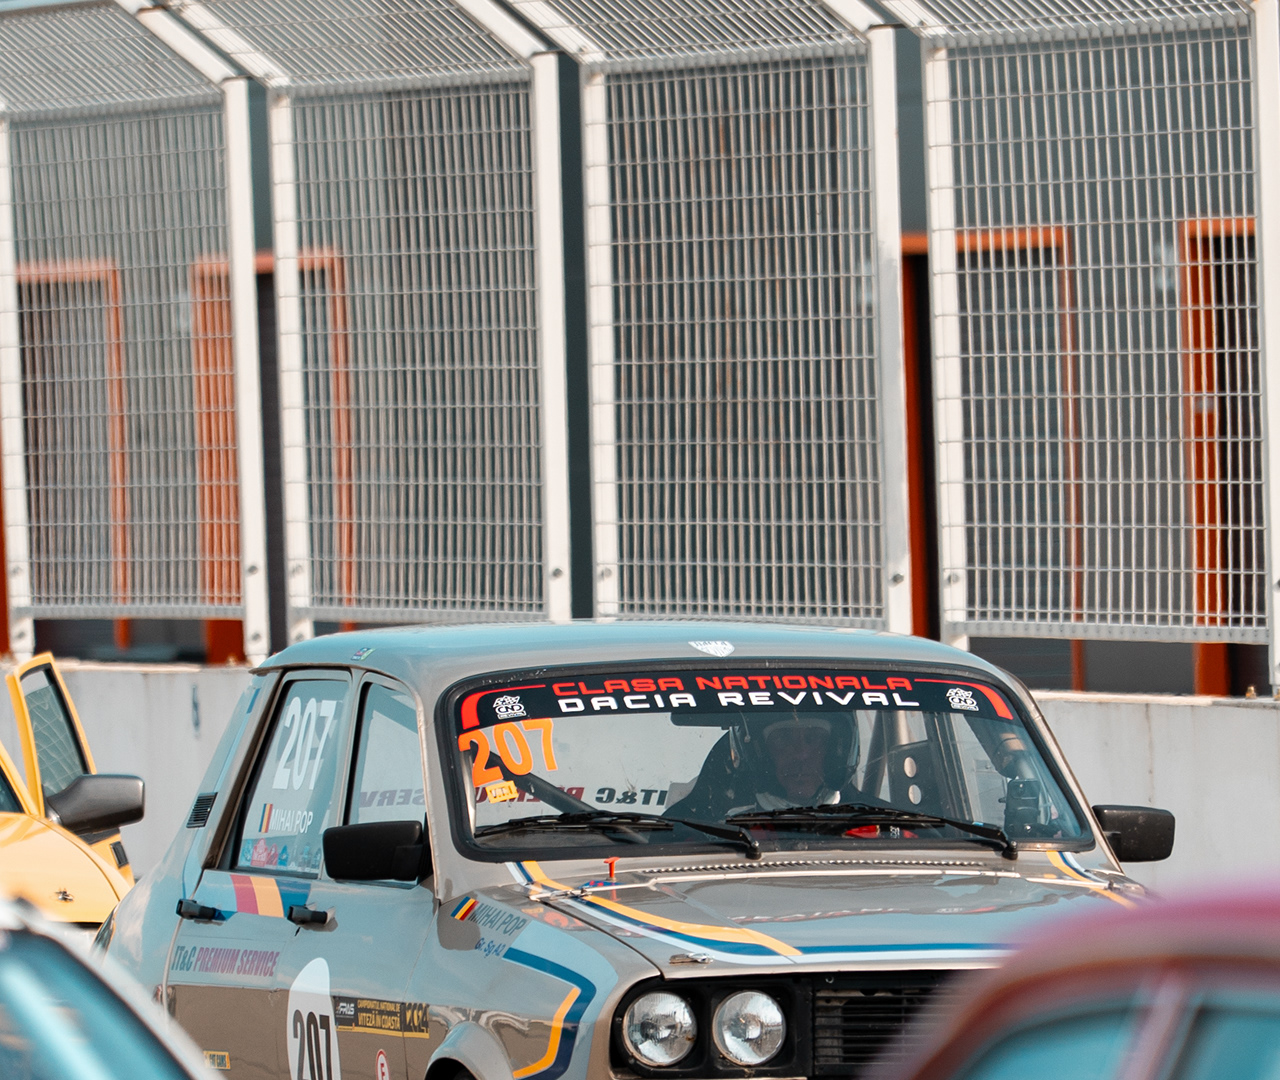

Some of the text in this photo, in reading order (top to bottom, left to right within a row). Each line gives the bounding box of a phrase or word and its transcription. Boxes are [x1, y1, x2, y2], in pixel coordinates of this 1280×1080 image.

[552, 675, 913, 697] CLASA NATIONALA
[558, 691, 920, 712] DACIA REVIVAL
[273, 697, 337, 790] 207
[458, 718, 558, 788] 207
[269, 809, 313, 834] MIHAI POP
[468, 903, 527, 936] MIHAI POP
[171, 946, 280, 977] IT&C PREMIUM SERVICE
